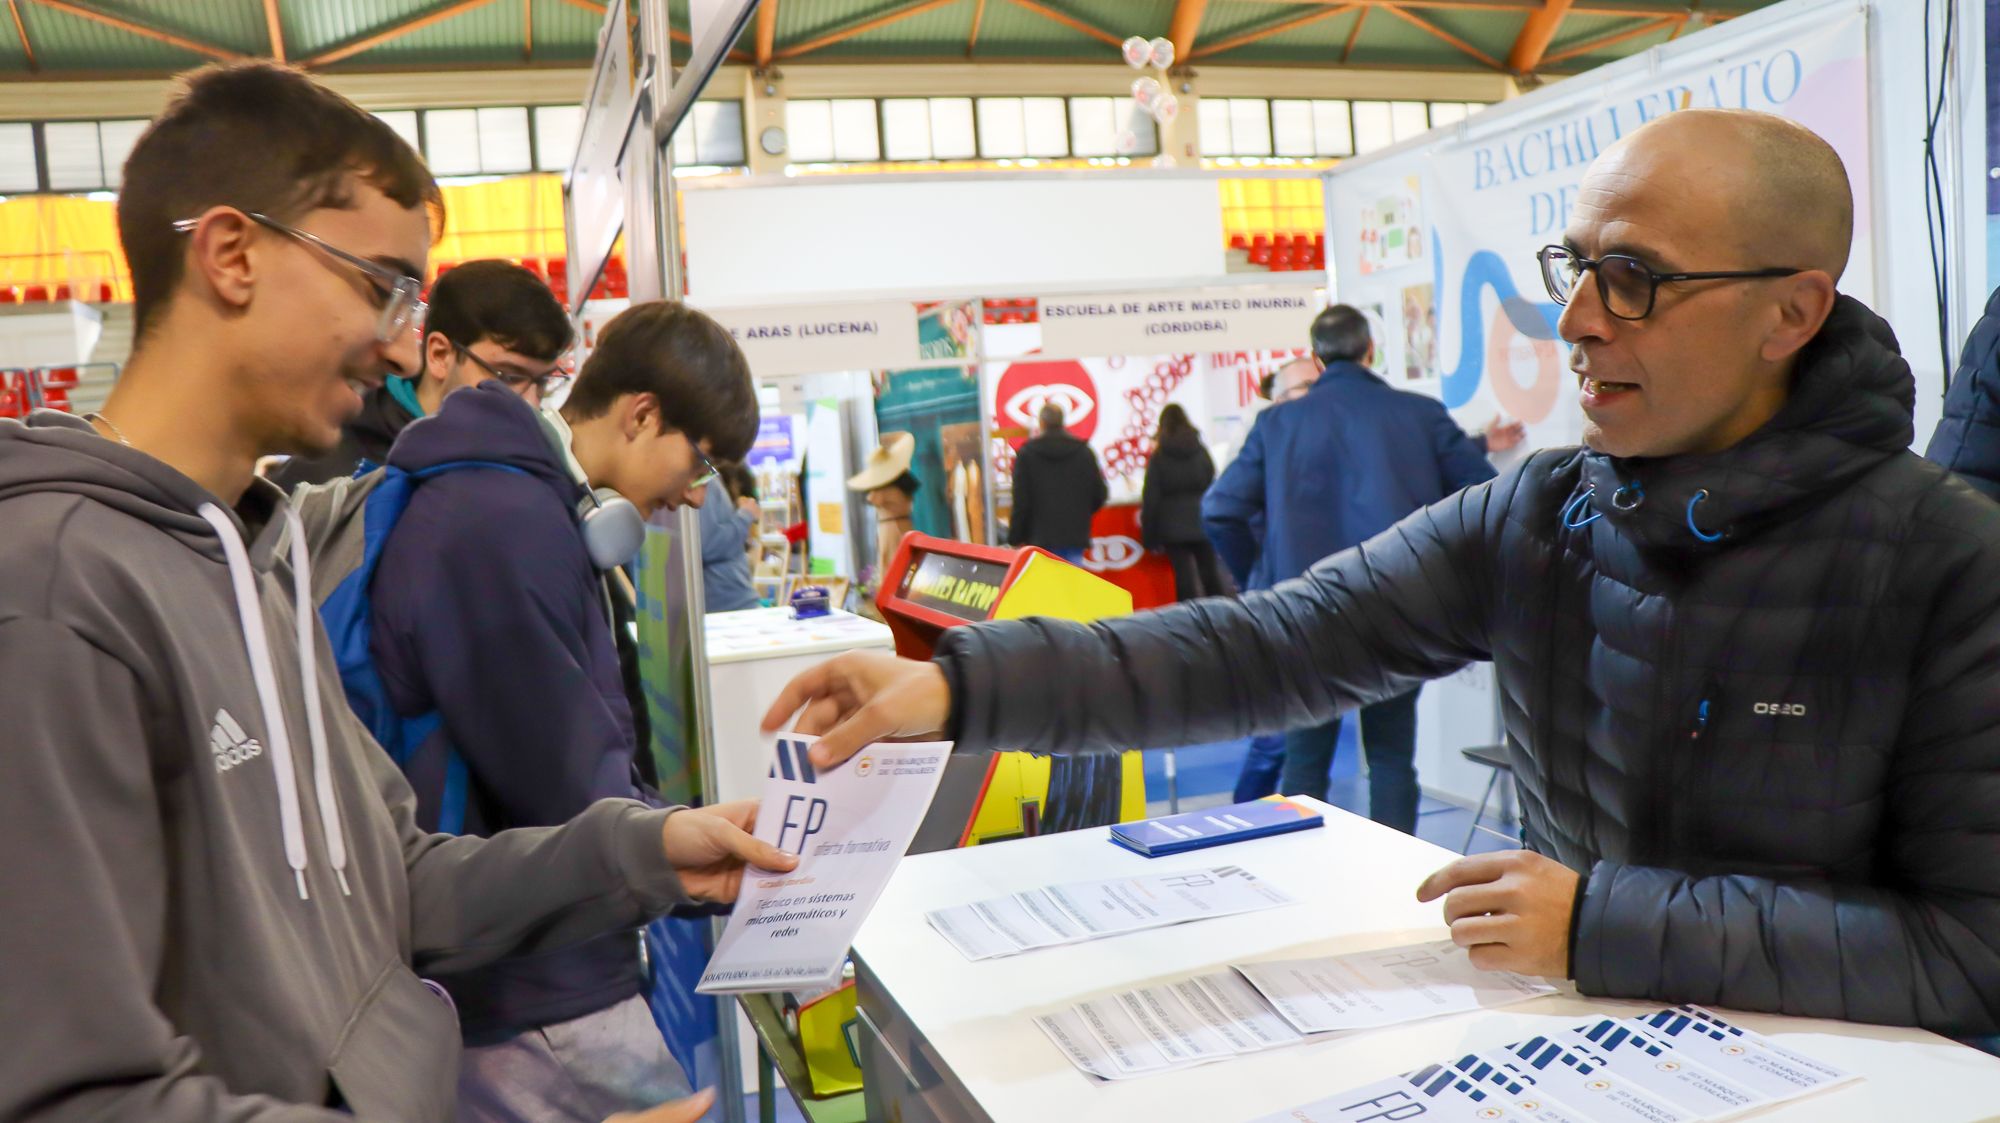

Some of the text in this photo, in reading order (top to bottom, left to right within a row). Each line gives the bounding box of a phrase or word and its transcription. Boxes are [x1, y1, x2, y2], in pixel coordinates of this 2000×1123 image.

[1045, 297, 1307, 317] ESCUELA DE ARTE MATEO INURRIA
[746, 324, 793, 339] ARAS
[799, 320, 879, 338] (LUCENA)
[777, 794, 828, 855] FP
[794, 896, 807, 905] en
[808, 892, 856, 904] sistemas
[745, 908, 847, 926] microinformáticos y
[770, 926, 799, 938] redes
[1340, 1090, 1428, 1123] FP
